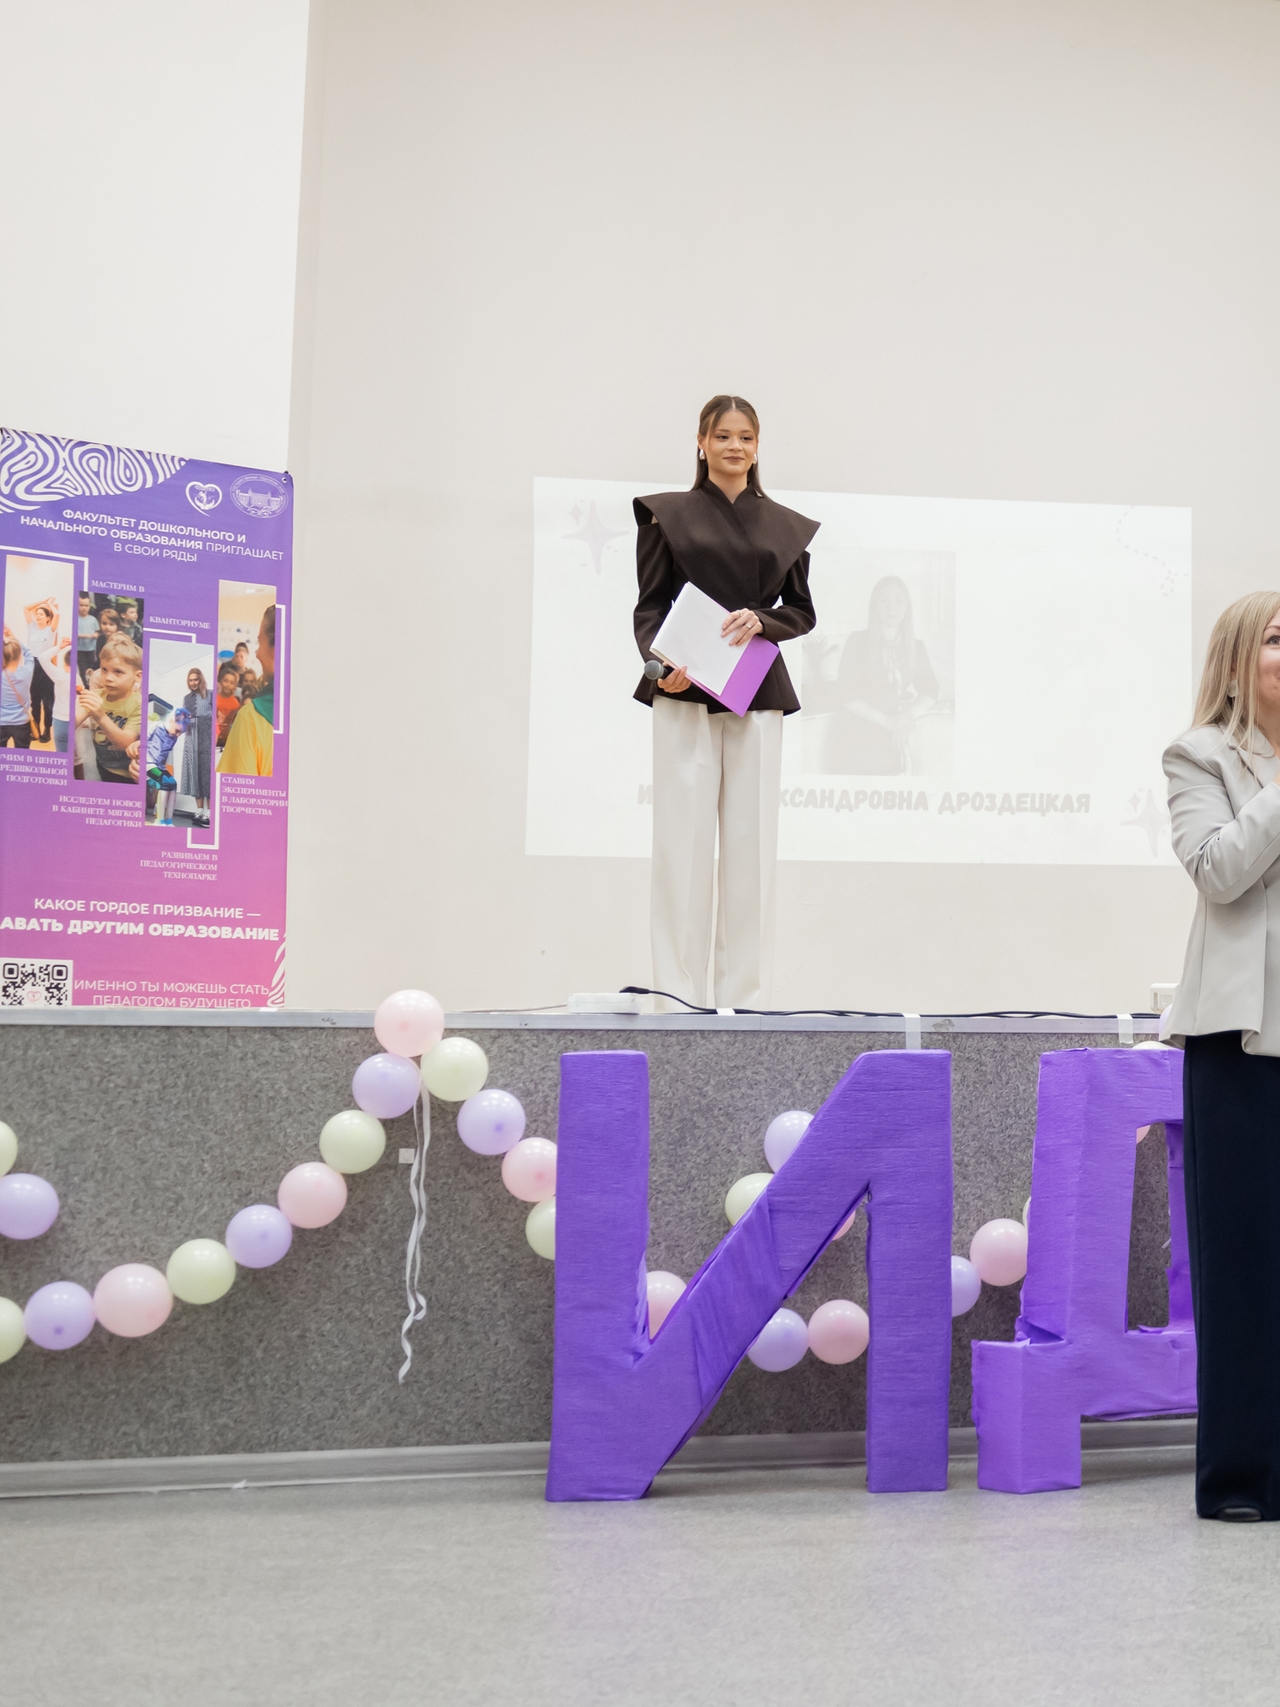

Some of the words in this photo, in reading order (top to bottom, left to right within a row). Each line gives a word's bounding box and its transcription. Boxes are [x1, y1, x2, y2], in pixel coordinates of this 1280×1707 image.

[62, 509, 137, 528] ФАКУЛЬТЕТ
[138, 519, 235, 542] ДОШКОЛЬНОГО
[237, 534, 246, 544] И
[20, 515, 107, 537] НАЧАЛЬНОГО
[110, 529, 203, 550] ОБРАЗОВАНИЯ
[206, 542, 284, 560] ПРИГЛАШАЕТ
[114, 543, 122, 552] В
[124, 543, 160, 557] СВОИ
[163, 549, 197, 562] РЯДЫ
[91, 580, 137, 592] МАСТЕРИМ
[138, 585, 145, 593] В
[149, 616, 211, 630] КВАНТОРИУМЕ
[0, 764, 68, 776] РЕДШКОЛЬНОЙ
[6, 774, 67, 786] ПОДГОТОВКИ
[221, 776, 255, 785] СТАВИМ
[221, 786, 287, 797] ЭКСПЕРИМЕНТЫ
[112, 799, 143, 808] НОВОЕ
[779, 787, 929, 813] КСАНДРОВНА
[937, 791, 1091, 817] ДРОЗДЕЦКАЯ
[52, 804, 58, 812] В
[60, 805, 105, 816] КАБИНЕТЕ
[107, 809, 142, 818] МЯГКОЙ
[221, 805, 273, 816] ТВОРЧЕСТВА
[85, 817, 142, 828] ПЕДАГОГИКИ
[161, 851, 210, 861] РАЗВИВАЕМ
[212, 853, 218, 861] В
[140, 860, 218, 871] ПЕДАГОГИЧЕСКОМ
[163, 871, 218, 881] ТЕХНОПАРКЕ
[34, 898, 86, 912] КАКОЕ
[90, 900, 150, 915] ГОРДОЕ
[153, 903, 244, 919] ПРИЗВАНИЕ
[0, 916, 64, 932] АВАТЬ
[67, 919, 144, 936] ДРУГИМ
[148, 923, 280, 941] ОБРАЗОВАНИЕ
[74, 979, 137, 992] ИМЕННО
[140, 980, 160, 992] ТЫ
[163, 982, 227, 994] МОЖЕШЬ
[229, 983, 270, 995] СТАТЬ
[93, 994, 176, 1007] ПЕДАГОГОМ
[180, 996, 251, 1008] БУДУЩЕГО
